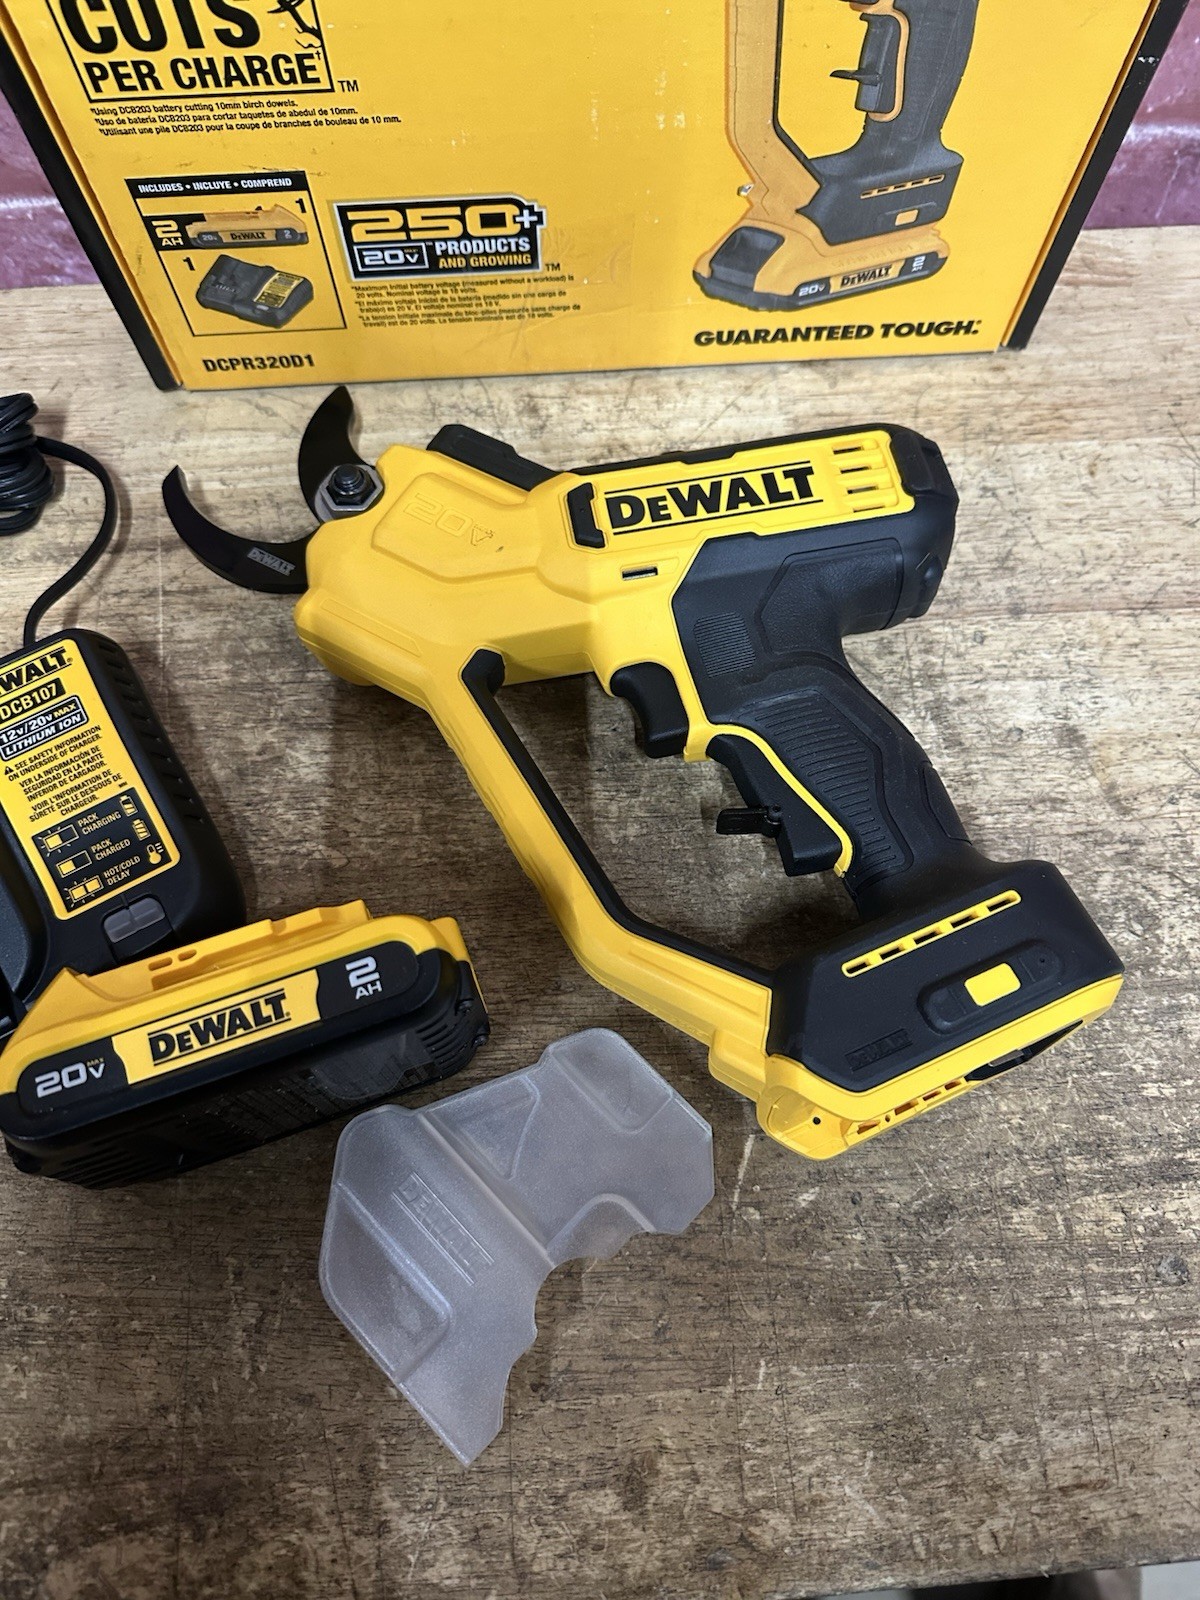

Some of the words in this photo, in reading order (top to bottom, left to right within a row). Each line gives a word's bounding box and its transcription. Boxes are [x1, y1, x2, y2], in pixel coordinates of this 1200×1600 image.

[83, 60, 164, 93] PER
[337, 79, 359, 92] TM
[119, 105, 151, 114] DCB203
[152, 104, 182, 113] battery
[185, 103, 214, 112] cutting
[216, 102, 241, 110] 10mm
[242, 101, 265, 109] birch
[266, 100, 298, 108] dowels.
[158, 114, 190, 123] DCB203
[192, 115, 211, 123] para
[213, 113, 237, 121] cortar
[239, 111, 275, 120] taquetes
[277, 110, 287, 118] de
[288, 109, 316, 117] abedul
[318, 108, 329, 116] de
[155, 126, 170, 135] pile
[206, 125, 224, 133] pour
[225, 122, 234, 130] la
[262, 121, 273, 129] de
[274, 120, 312, 128] branches
[313, 119, 324, 127] de
[325, 118, 358, 126] bouleau
[371, 116, 382, 124] 10
[138, 183, 184, 193] INCLUDES
[192, 181, 232, 191] INCLUYE
[241, 178, 293, 189] COMPREND
[295, 198, 307, 214] 1
[152, 220, 182, 239] 2
[162, 236, 184, 247] AH
[435, 237, 531, 256] PRODUCTS
[183, 257, 195, 271] 1
[439, 257, 467, 269] AND
[470, 254, 532, 268] GROWING
[694, 324, 874, 347] GUARANTEED
[202, 354, 315, 372] DCPR320D1
[0, 683, 57, 720] DCB107
[53, 703, 77, 718] MAX
[5, 727, 56, 756] LITHIUM
[59, 714, 82, 730] ION
[15, 760, 28, 770] SEE
[29, 748, 54, 764] SAFETY
[54, 725, 102, 751] INFORMATION
[8, 773, 20, 782] ON
[20, 754, 59, 776] UNDERSIDE
[60, 749, 68, 757] OF
[69, 734, 103, 752] CHARGER.
[20, 778, 34, 788] VER
[91, 745, 101, 754] DE
[24, 773, 62, 795] SEGURIDAD
[62, 767, 73, 777] EN
[73, 763, 82, 771] LA
[82, 752, 104, 767] PARTE
[27, 783, 59, 802] INFERIOR
[59, 778, 69, 787] DE
[69, 761, 107, 782] CARGADOR.
[32, 799, 50, 812] VOIR
[102, 769, 113, 778] DE
[56, 798, 71, 810] SUR
[71, 793, 80, 802] LE
[80, 778, 112, 798] DESSOUS
[112, 773, 123, 782] DE
[60, 794, 99, 816] CHARGEUR.
[78, 813, 99, 828] PACK
[82, 811, 122, 835] CHARGING
[91, 838, 113, 853] PACK
[95, 839, 131, 861] CHARGED
[103, 856, 141, 878] HOT/COLD
[107, 869, 131, 886] DELAY
[345, 956, 380, 988] 2
[355, 980, 383, 1000] AH
